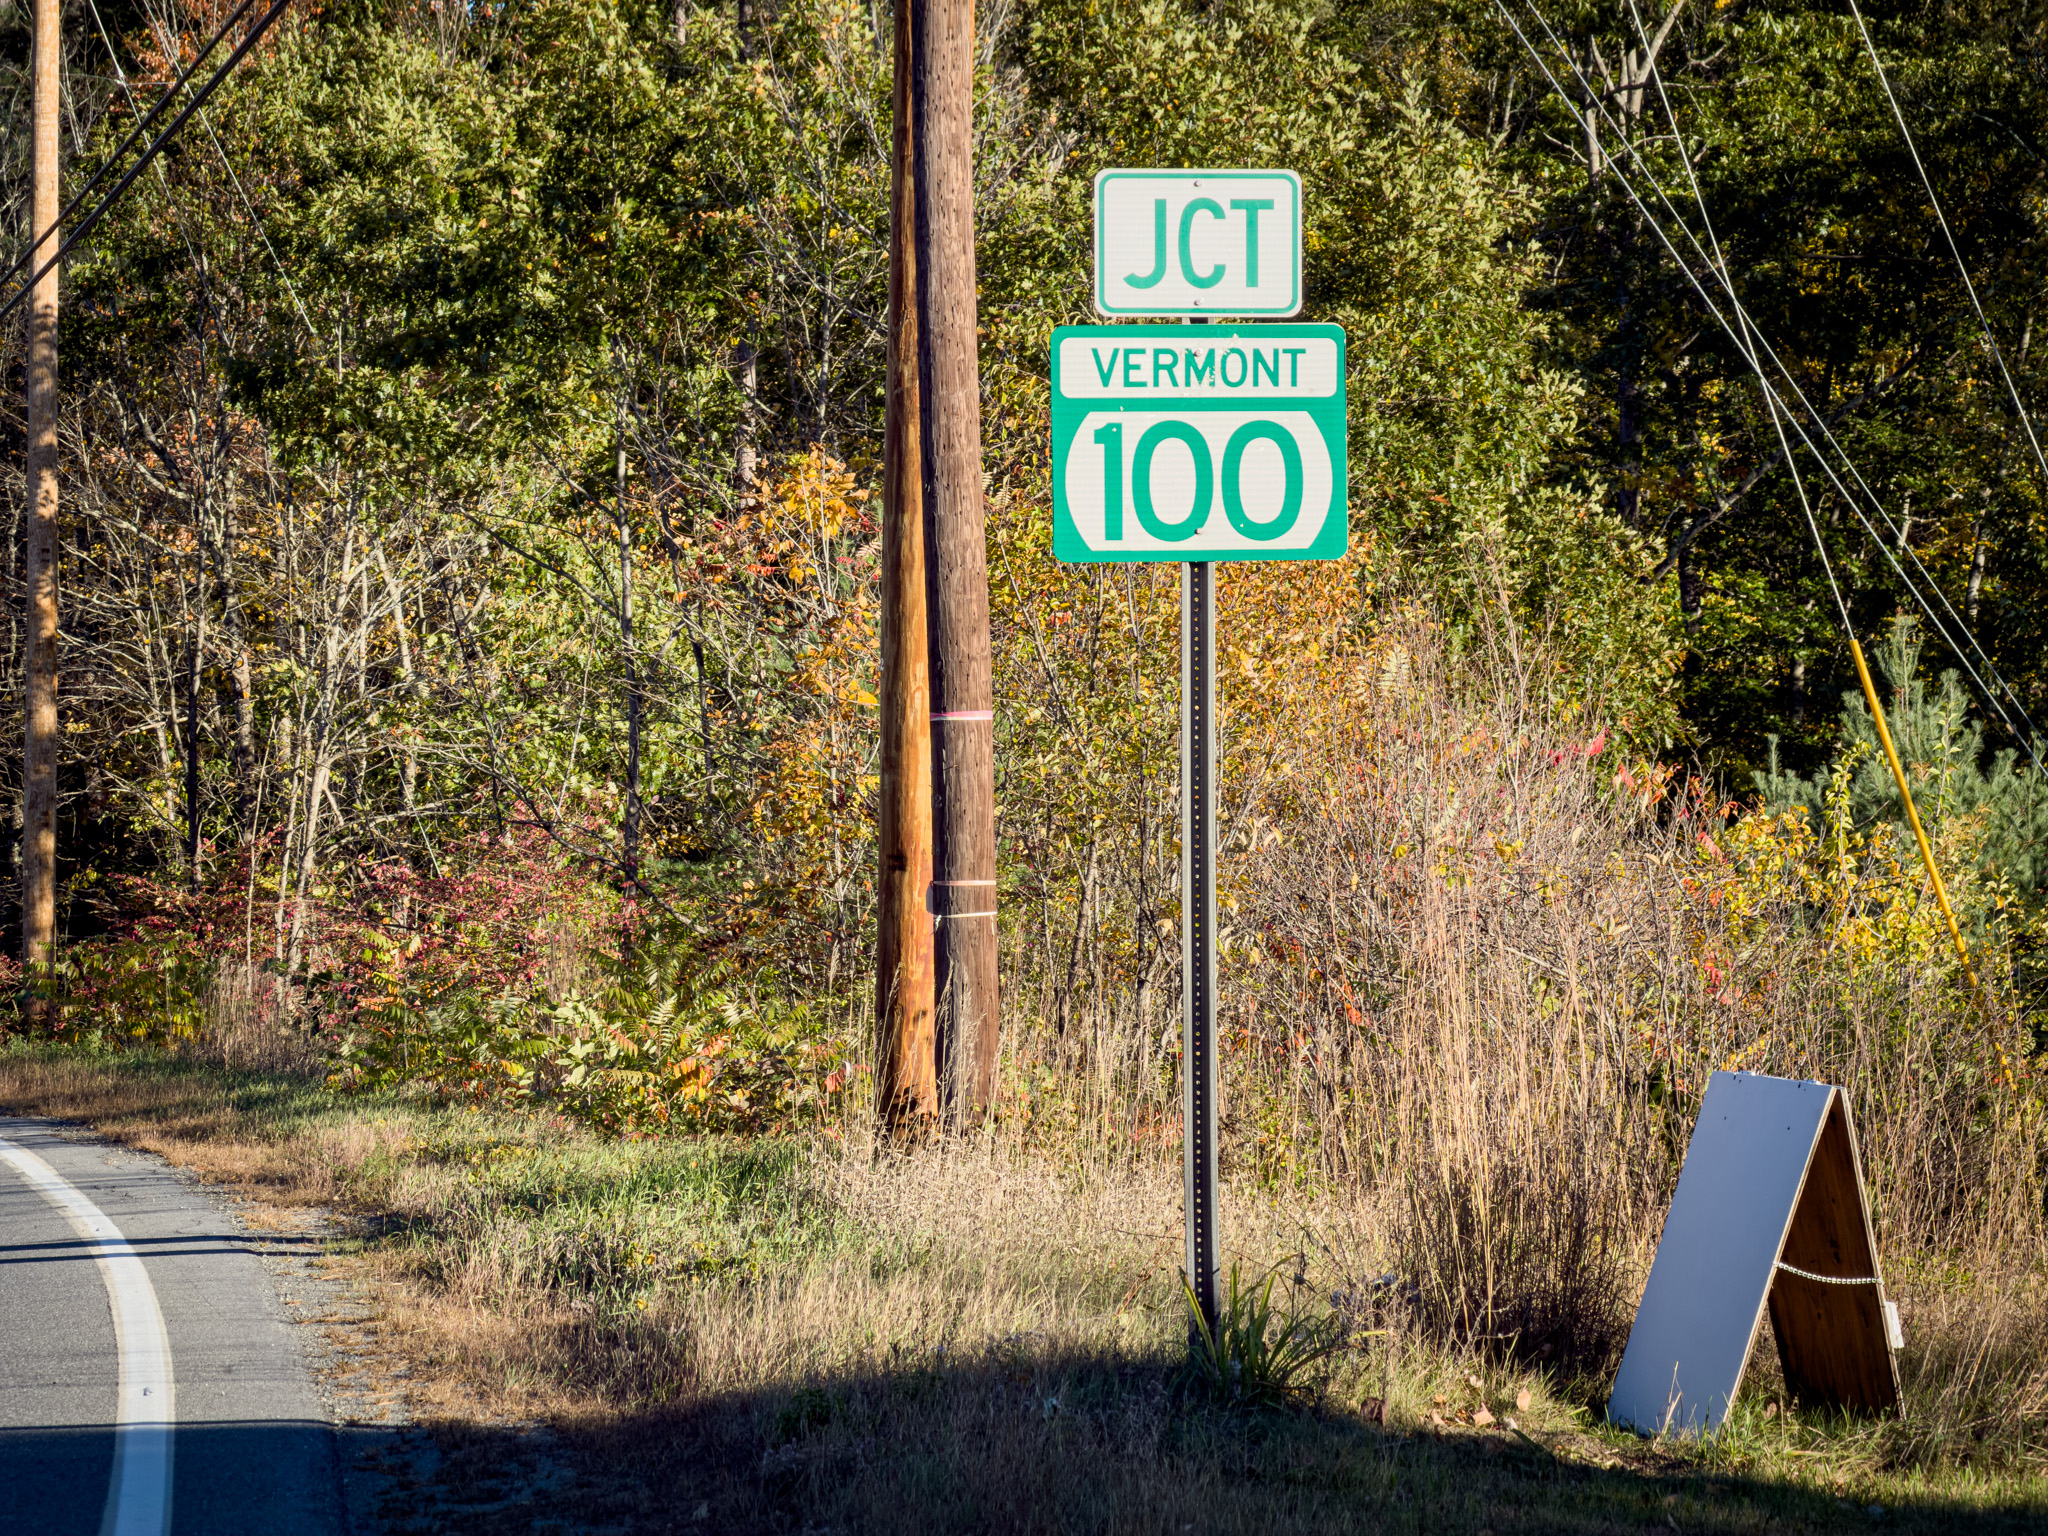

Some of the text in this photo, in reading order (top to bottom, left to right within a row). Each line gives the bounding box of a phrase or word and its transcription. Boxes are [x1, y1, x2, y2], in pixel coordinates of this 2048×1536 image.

[1122, 197, 1274, 290] JCT
[1091, 347, 1306, 388] VERMONT
[1093, 419, 1303, 542] 100
